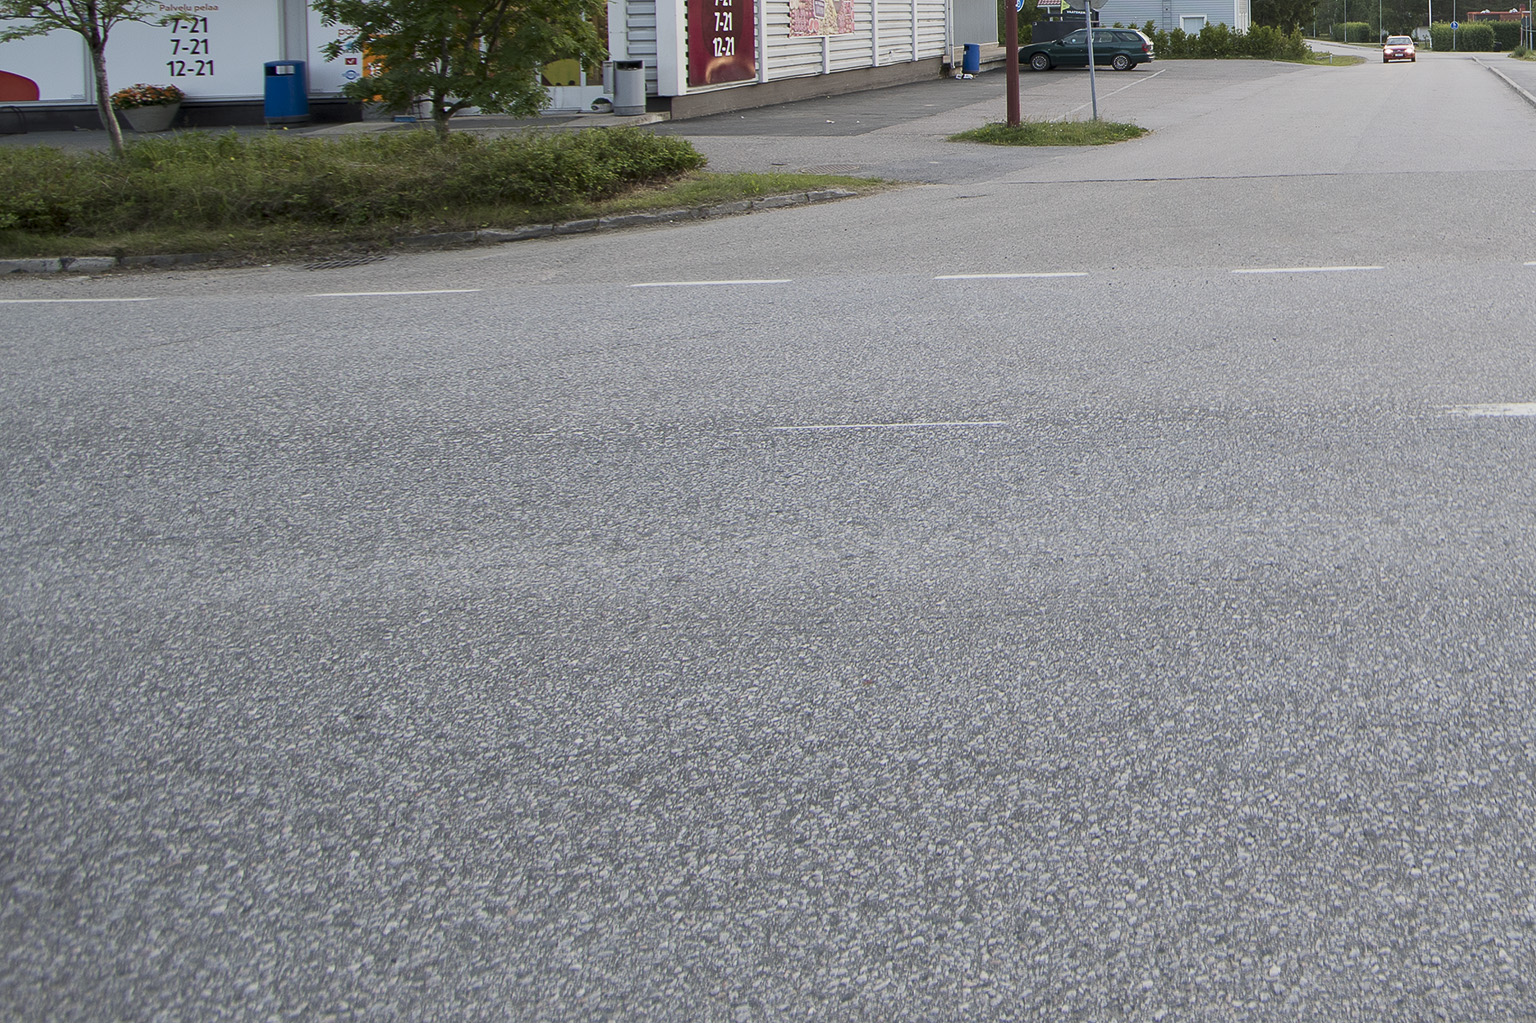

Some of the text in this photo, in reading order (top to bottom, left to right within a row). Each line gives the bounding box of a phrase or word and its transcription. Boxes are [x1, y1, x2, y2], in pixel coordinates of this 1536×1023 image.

[159, 3, 219, 13] Palvelu pelaa
[171, 16, 209, 34] 7-21
[170, 38, 209, 55] 7-21
[166, 59, 214, 77] 12-21
